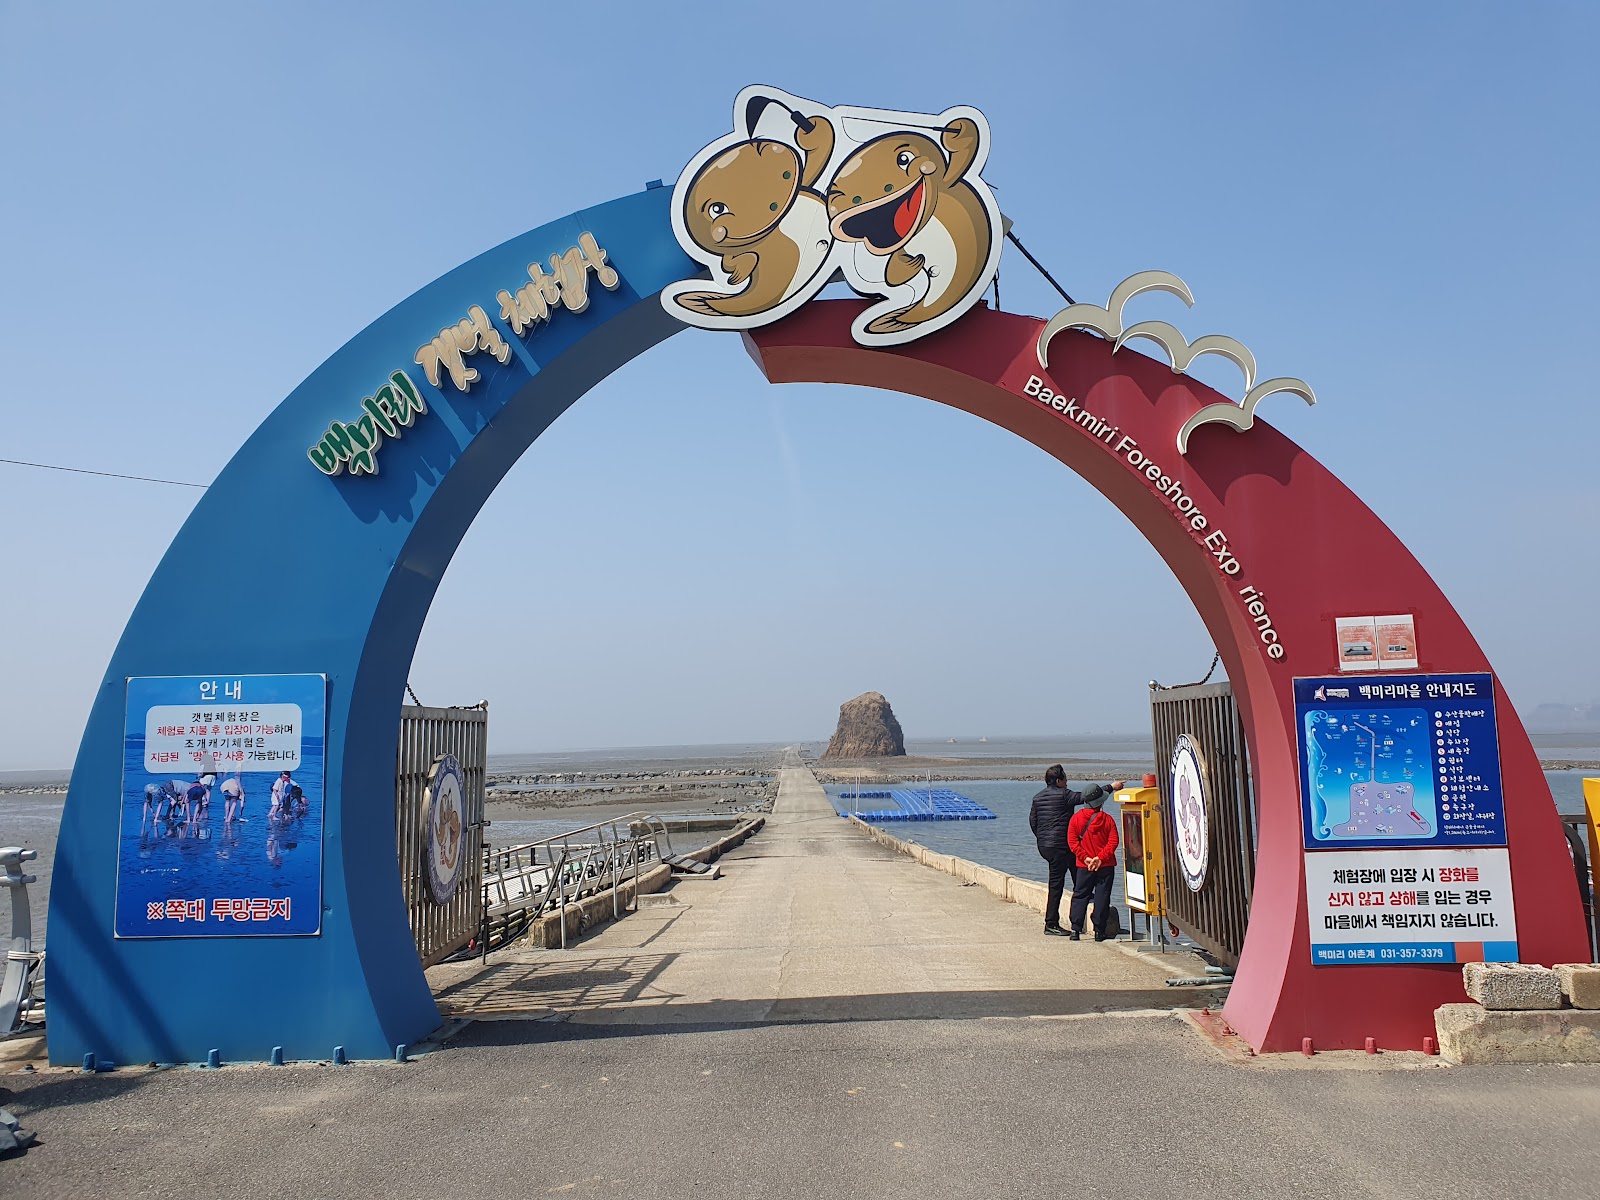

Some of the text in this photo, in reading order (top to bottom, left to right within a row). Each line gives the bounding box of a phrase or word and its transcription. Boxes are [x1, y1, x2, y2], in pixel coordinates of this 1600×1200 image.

[307, 369, 425, 475] 백미리
[414, 305, 509, 391] 갯벌
[1023, 375, 1119, 443] Baekmiri
[1115, 436, 1207, 530] Foreshore
[1358, 683, 1421, 699] 백미리마을
[1426, 683, 1477, 698] 안내지도
[192, 711, 260, 723] 갯벌체험장은
[157, 724, 293, 736] 체험료 지불 후 입장이 가능하며
[184, 737, 265, 748] 조개캐기체험은
[150, 752, 179, 762] 지급된
[212, 751, 222, 762] 만
[225, 751, 244, 761] 사용
[247, 750, 298, 761] 가능합니다.
[1333, 867, 1479, 884] 체험장에 입장 시 장화를
[1328, 890, 1492, 907] 신지 않고 상해를 입는 경우
[211, 897, 291, 922] 투망금지
[1324, 912, 1498, 930] 마을에서 책임지지 않습니다.
[1318, 950, 1345, 959] 백미리
[1381, 948, 1444, 958] 031-357-3379
